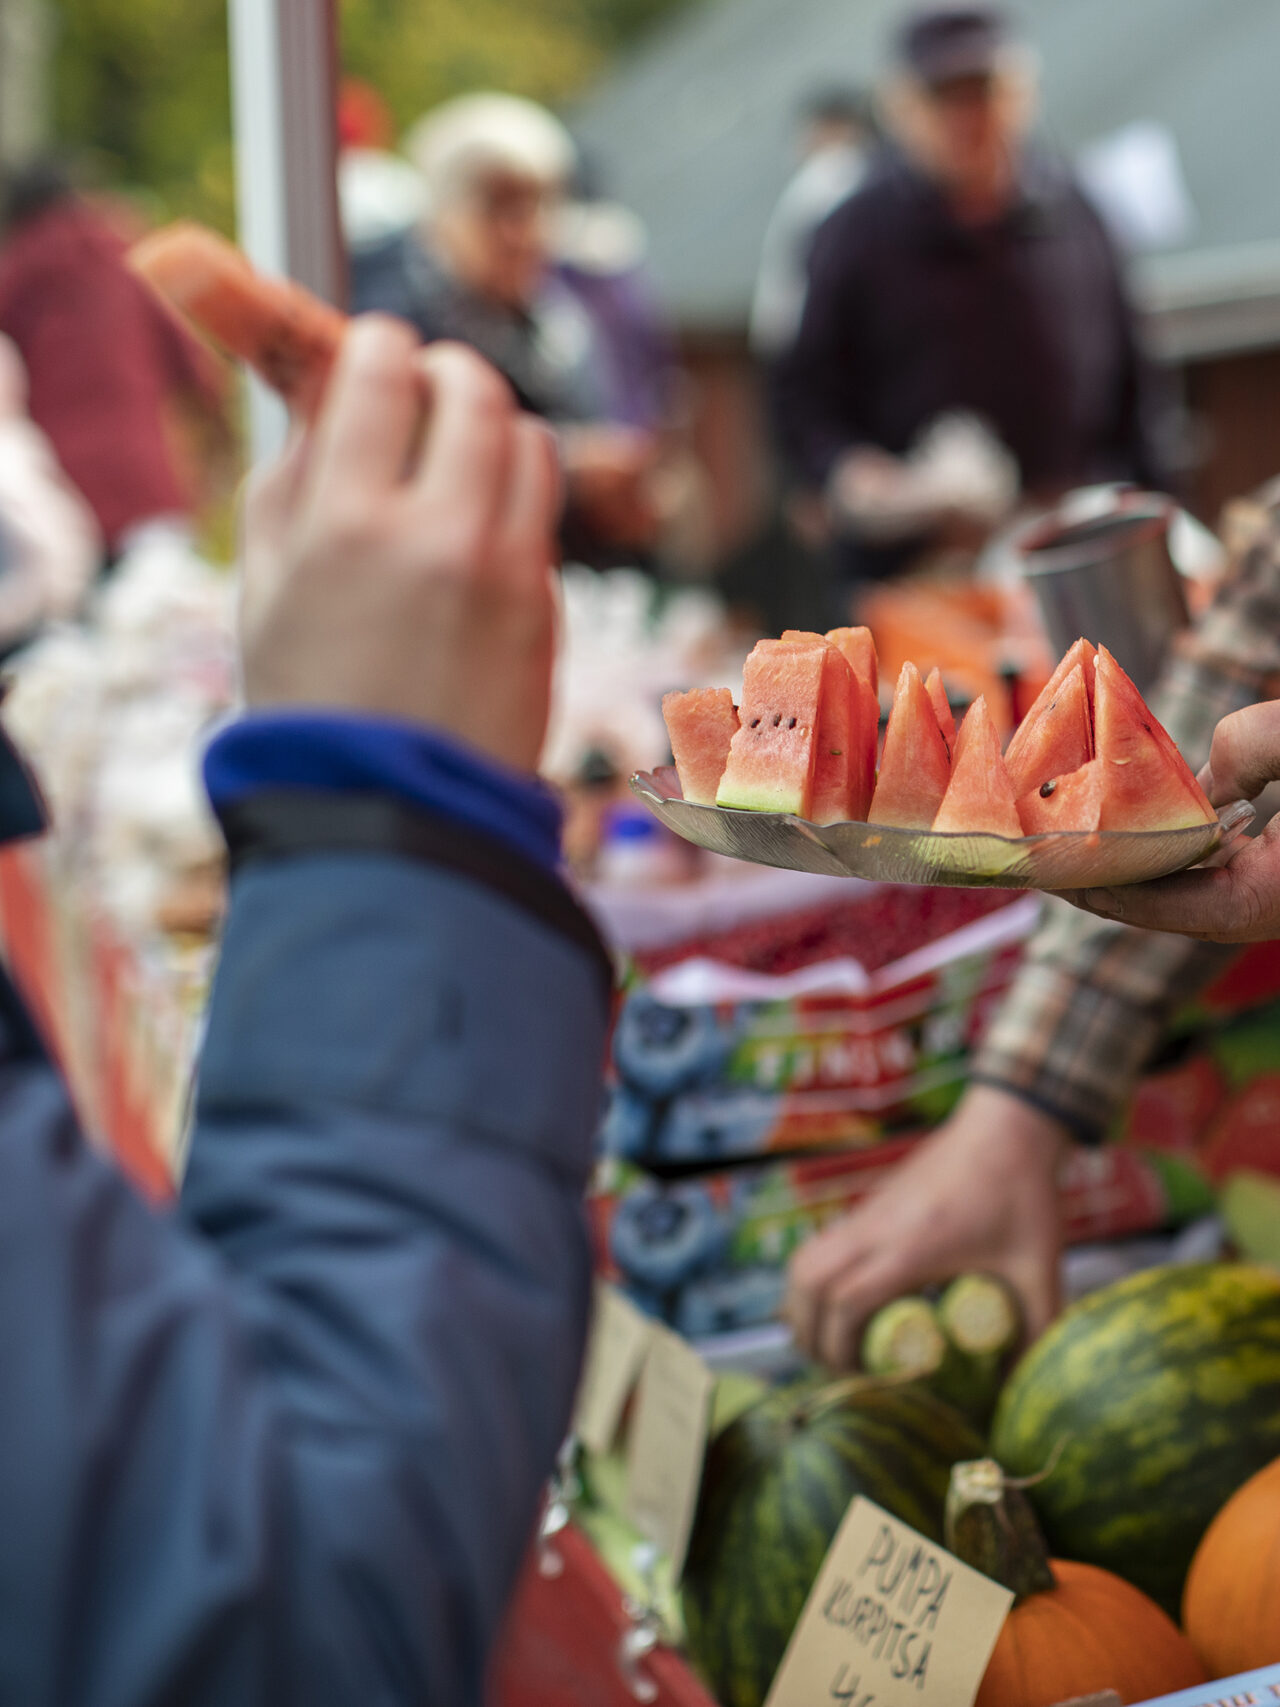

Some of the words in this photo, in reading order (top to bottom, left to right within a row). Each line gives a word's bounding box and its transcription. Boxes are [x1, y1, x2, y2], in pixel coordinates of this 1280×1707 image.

[822, 1575, 933, 1691] KURPITSA
[857, 1523, 953, 1633] PUMPA
[829, 1662, 876, 1707] 4
